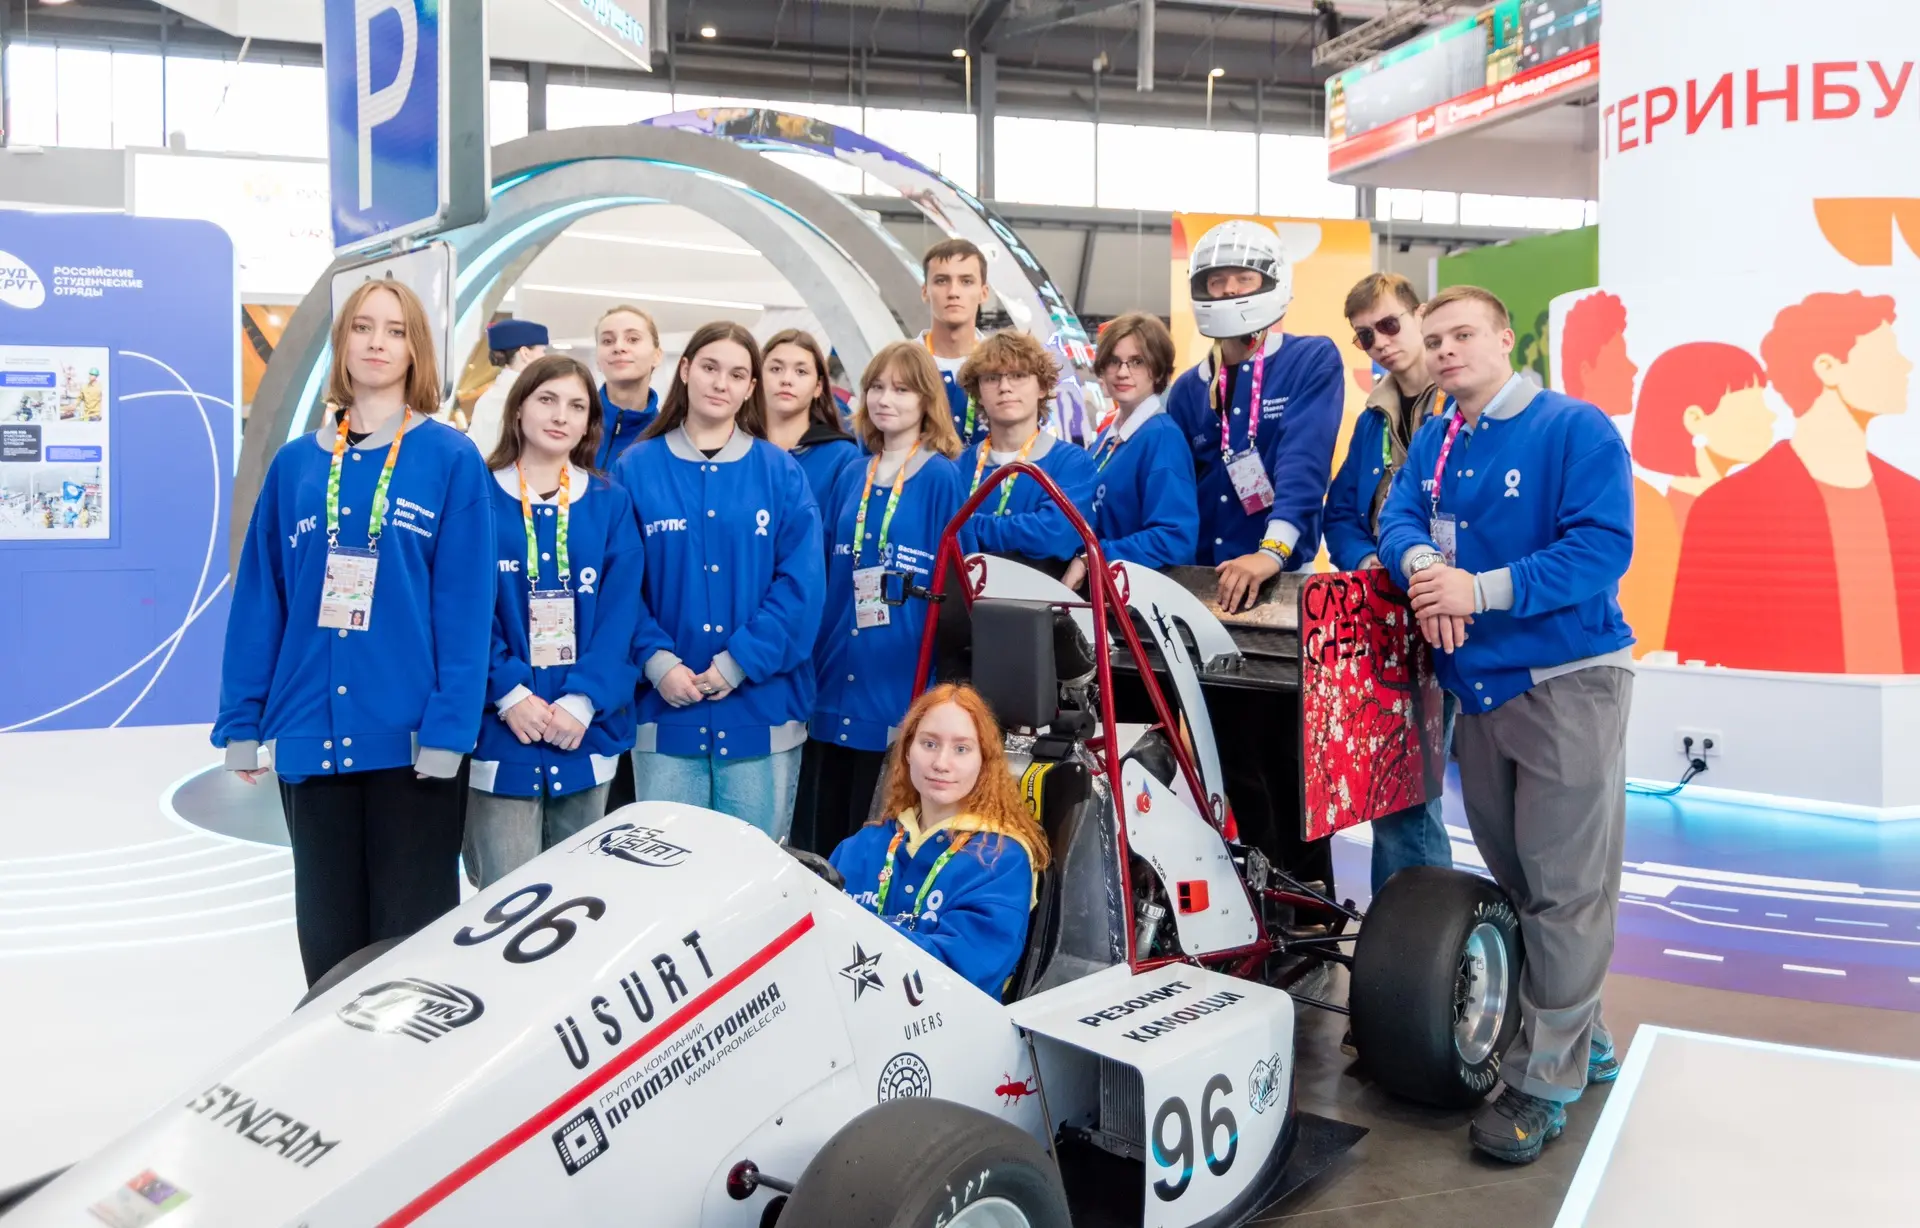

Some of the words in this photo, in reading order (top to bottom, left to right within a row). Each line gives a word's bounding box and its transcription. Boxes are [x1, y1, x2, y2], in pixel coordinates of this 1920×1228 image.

[355, 0, 418, 211] P
[0, 279, 38, 290] РУТ
[53, 265, 134, 278] РОССИЙСКИЕ
[53, 276, 143, 289] СТУДЕНЧЕСКИЕ
[53, 286, 103, 297] ОТРЯДЫ
[393, 508, 416, 521] Анна
[644, 518, 688, 537] рГУПС
[453, 883, 606, 964] 96
[554, 930, 713, 1069] USURT
[1077, 980, 1193, 1027] РЕЗОНИТ
[1121, 991, 1245, 1043] КАМОЦЦИ
[684, 1001, 787, 1086] WWW.PROMELEC.RU
[904, 1012, 943, 1041] UNERS
[599, 1071, 644, 1108] ГРУППА
[644, 1022, 705, 1072] КОМПАНИЙ
[604, 982, 781, 1129] ПРОМЭЛЕКТРОНИКА
[186, 1083, 342, 1168] SYNCAM
[1152, 1073, 1239, 1202] 96
